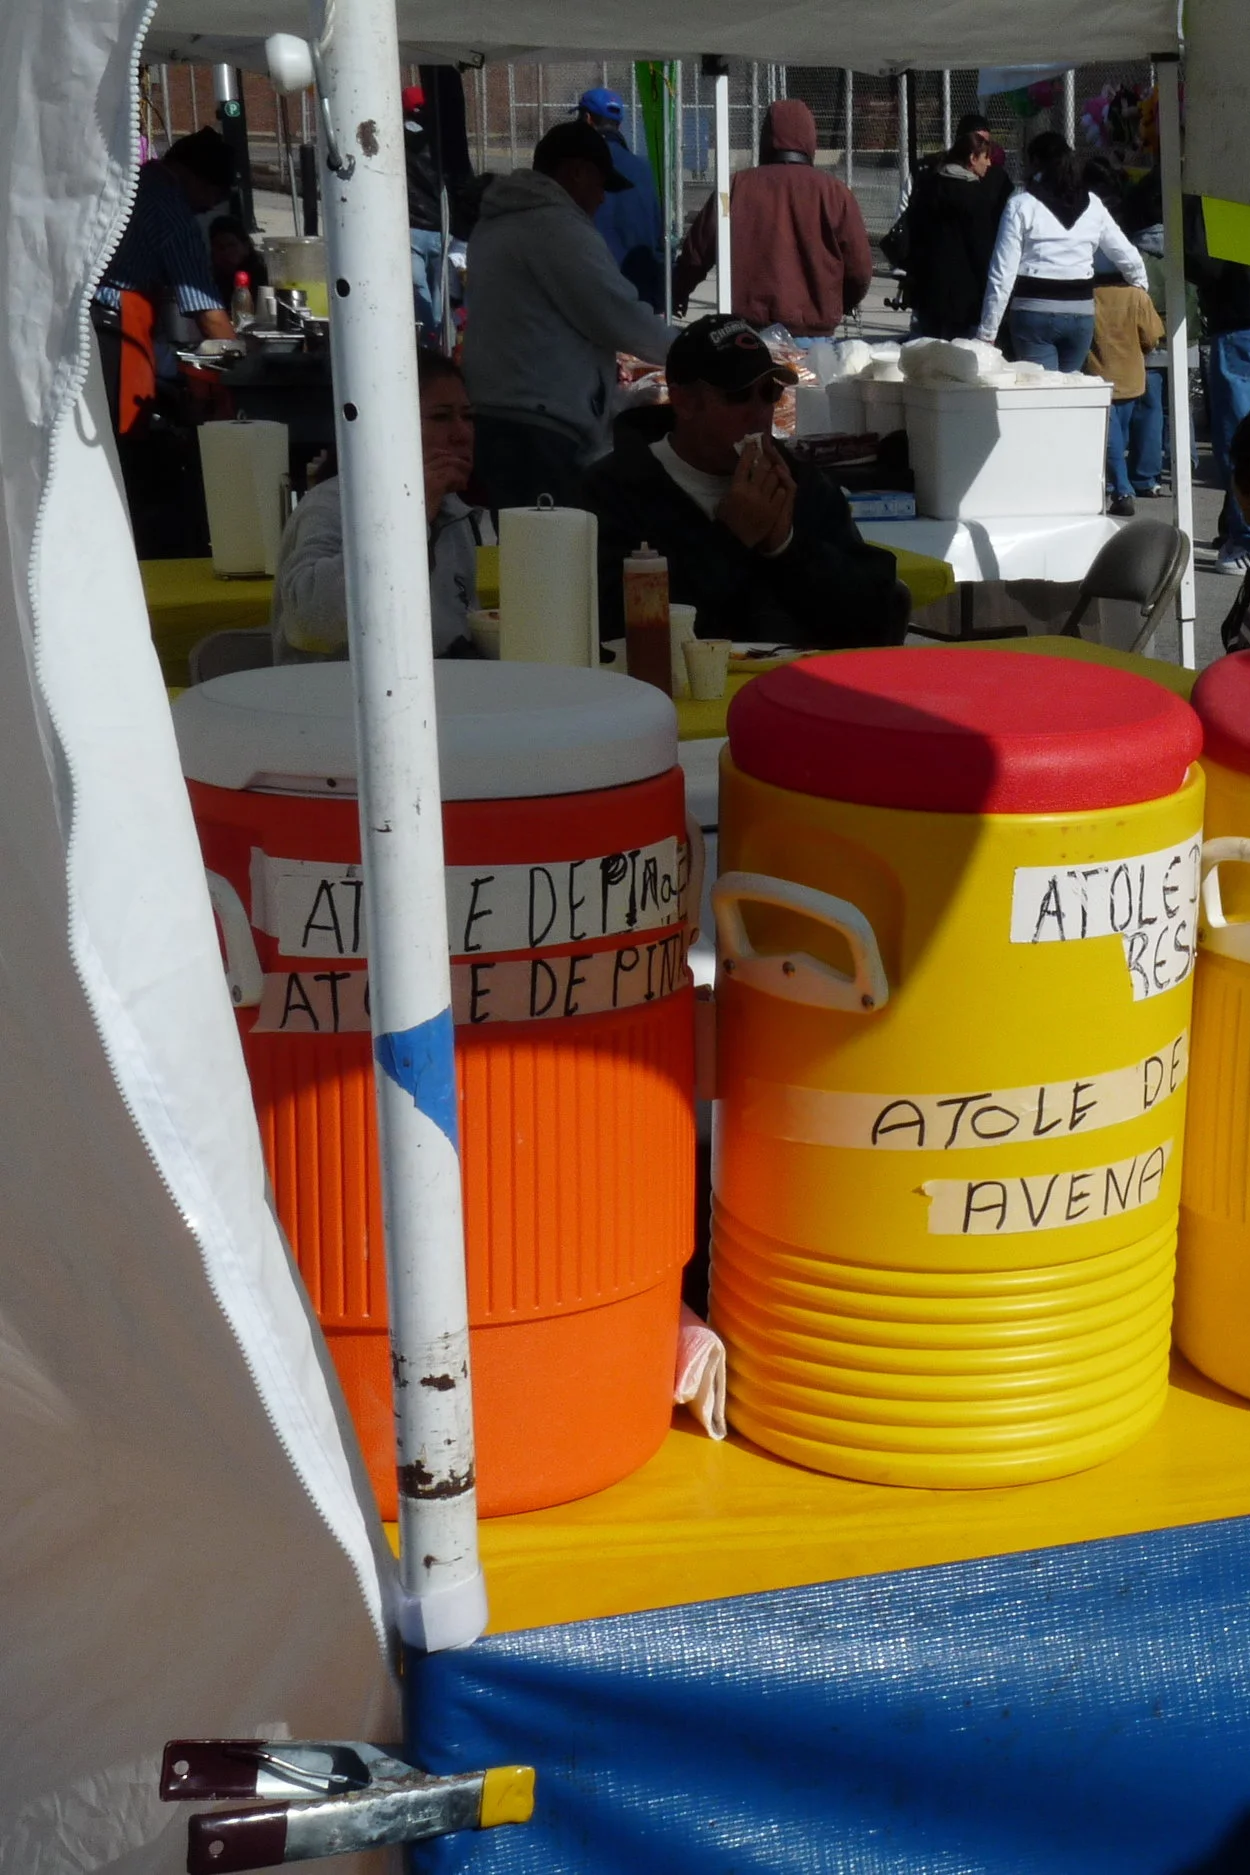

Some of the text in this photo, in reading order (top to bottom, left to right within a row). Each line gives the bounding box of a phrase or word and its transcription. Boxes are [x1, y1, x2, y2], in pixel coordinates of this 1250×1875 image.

[302, 875, 494, 954] ATE
[1032, 856, 1181, 945] ATOLE
[279, 963, 496, 1034] ATE
[529, 953, 593, 1017] DE
[872, 1036, 1183, 1150] ATOLE DE
[962, 1146, 1165, 1233] AVENA
